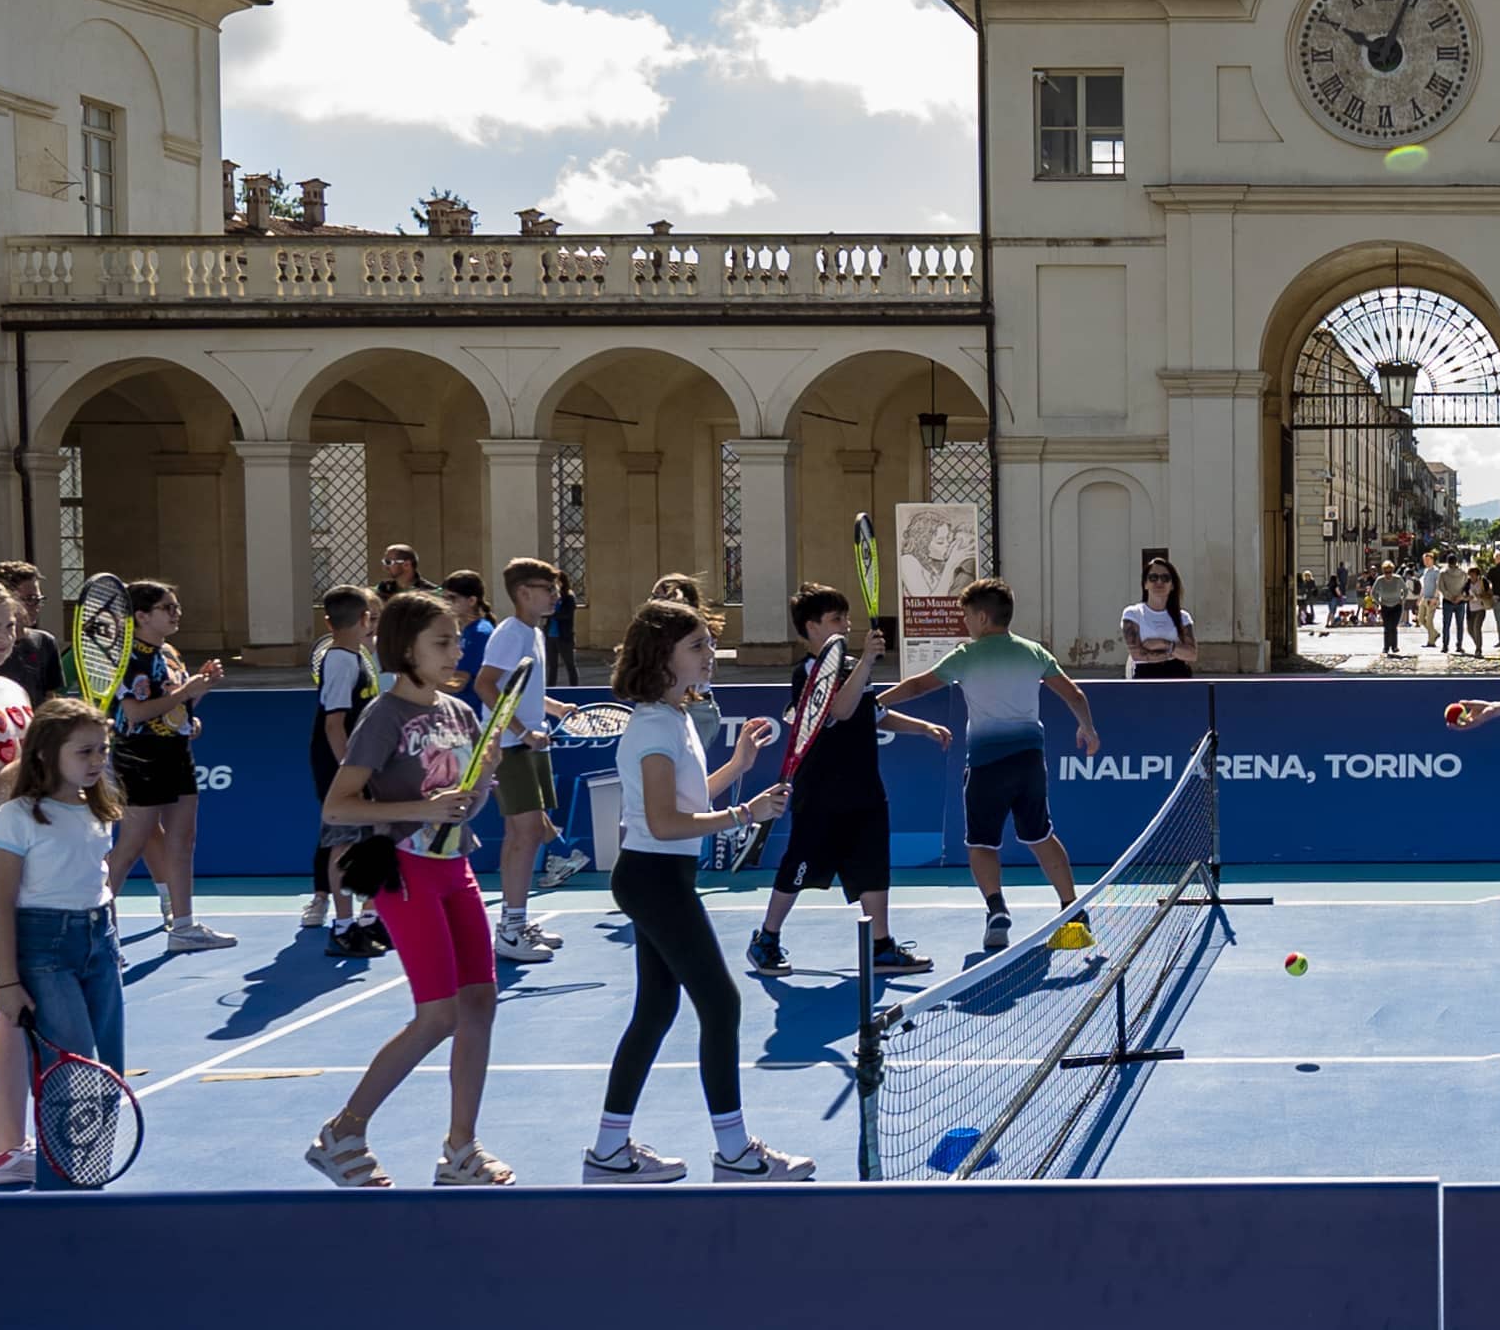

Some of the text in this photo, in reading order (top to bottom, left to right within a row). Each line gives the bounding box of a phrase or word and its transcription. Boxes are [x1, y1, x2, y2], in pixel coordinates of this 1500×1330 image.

[905, 598, 925, 608] Milo
[1058, 755, 1173, 780] INALPI
[1324, 753, 1462, 779] TORINO
